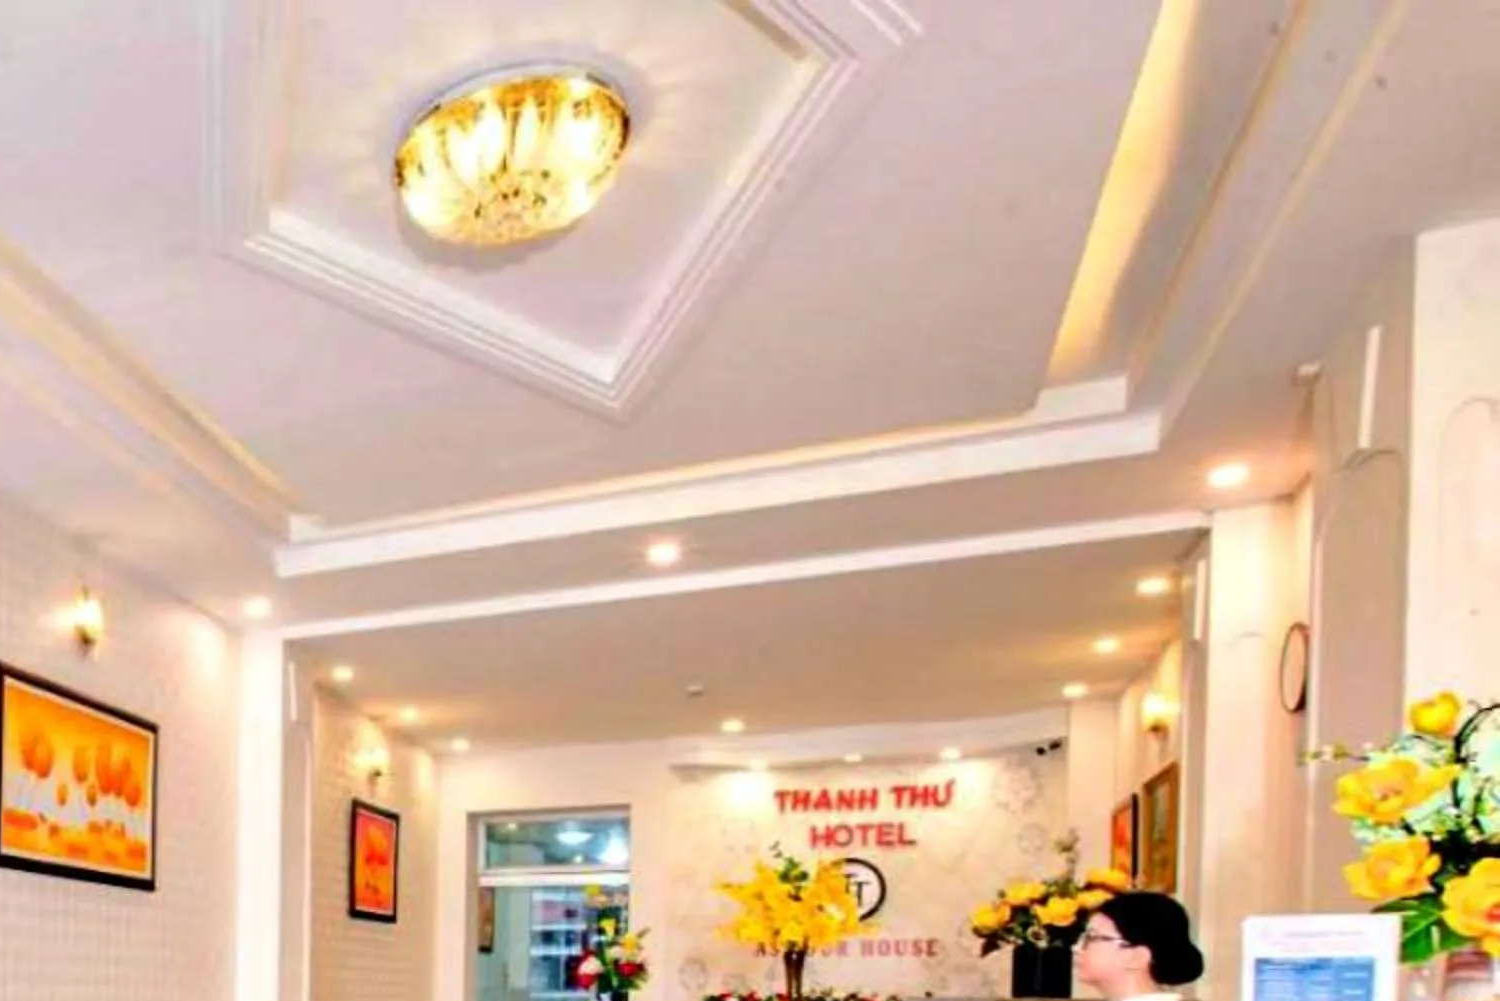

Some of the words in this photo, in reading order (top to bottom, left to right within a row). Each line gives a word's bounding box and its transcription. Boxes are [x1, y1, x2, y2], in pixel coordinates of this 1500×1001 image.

[774, 788, 879, 814] THANH
[810, 823, 916, 850] HOTEL
[860, 938, 939, 957] HOUSE
